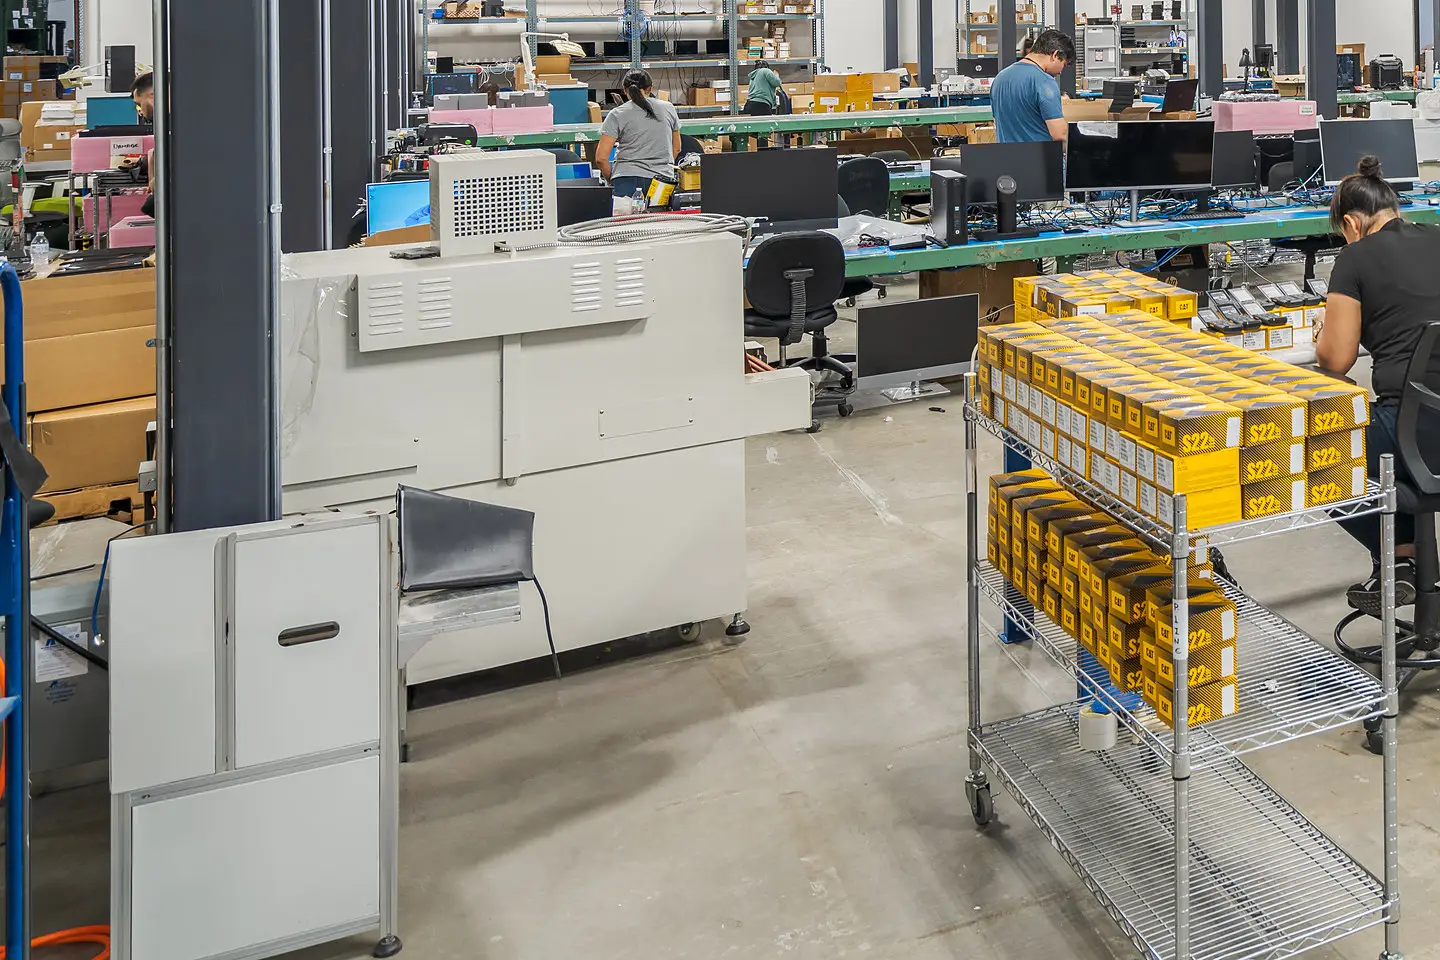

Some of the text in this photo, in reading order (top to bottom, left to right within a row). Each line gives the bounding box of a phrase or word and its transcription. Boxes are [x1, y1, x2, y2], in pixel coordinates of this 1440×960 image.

[1314, 412, 1339, 431] S22
[1183, 432, 1209, 453] S22
[1250, 422, 1276, 443] S22
[1312, 447, 1337, 467] S22
[1247, 459, 1273, 480] S22
[1311, 482, 1336, 503] S22
[1249, 495, 1275, 516] S22
[1133, 602, 1146, 620] S2
[1161, 628, 1169, 638] CAT
[1189, 629, 1205, 650] 22
[1146, 649, 1154, 658] CAT
[1126, 670, 1143, 689] S2
[1189, 664, 1205, 686] 22
[1162, 702, 1170, 713] CAT
[1189, 703, 1205, 725] 22
